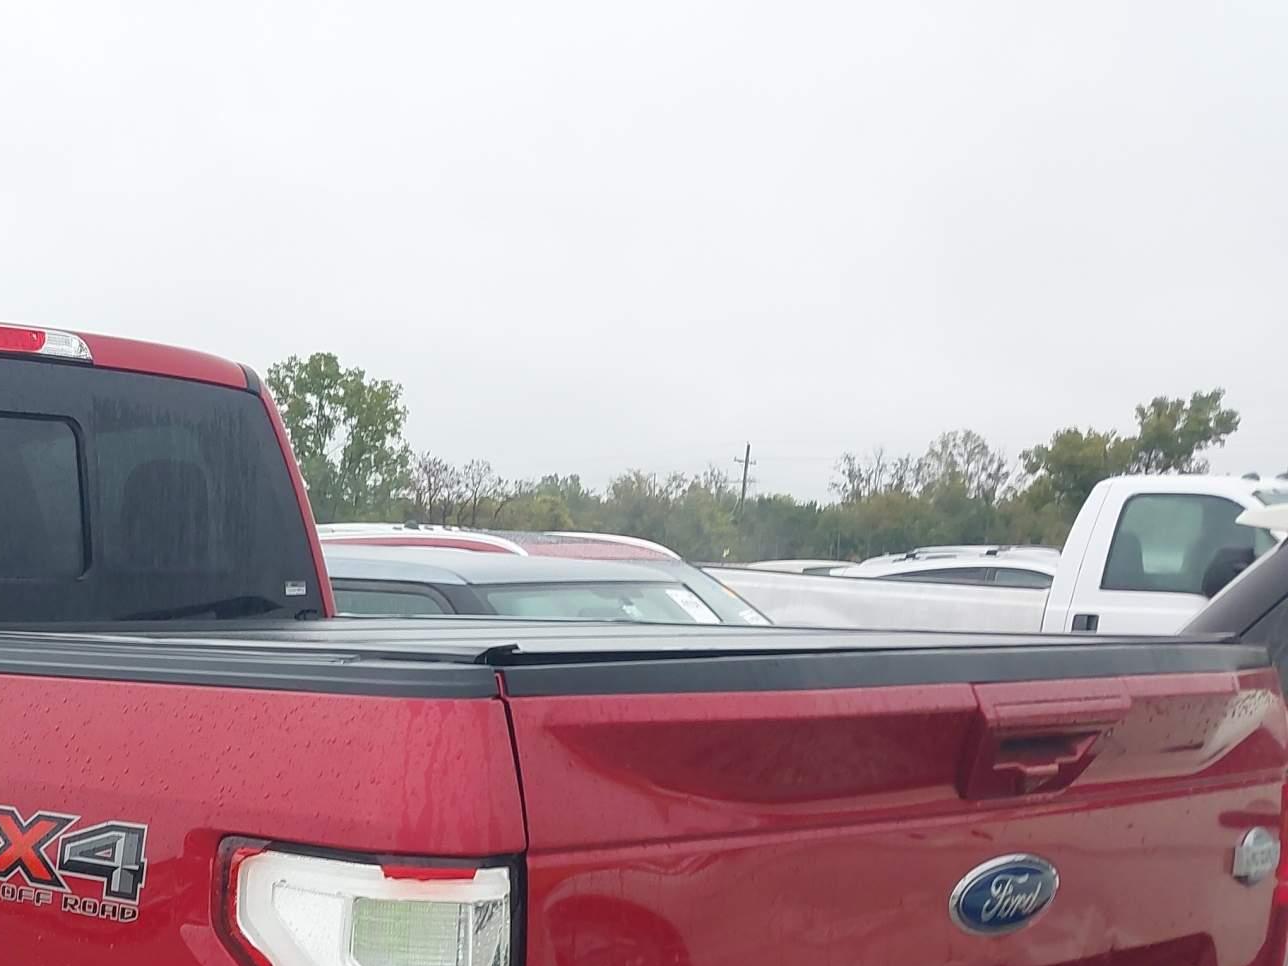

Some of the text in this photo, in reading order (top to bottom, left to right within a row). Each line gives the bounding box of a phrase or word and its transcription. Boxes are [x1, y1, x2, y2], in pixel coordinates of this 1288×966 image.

[0, 883, 140, 923] OFF ROAD
[981, 873, 1042, 922] Ford
